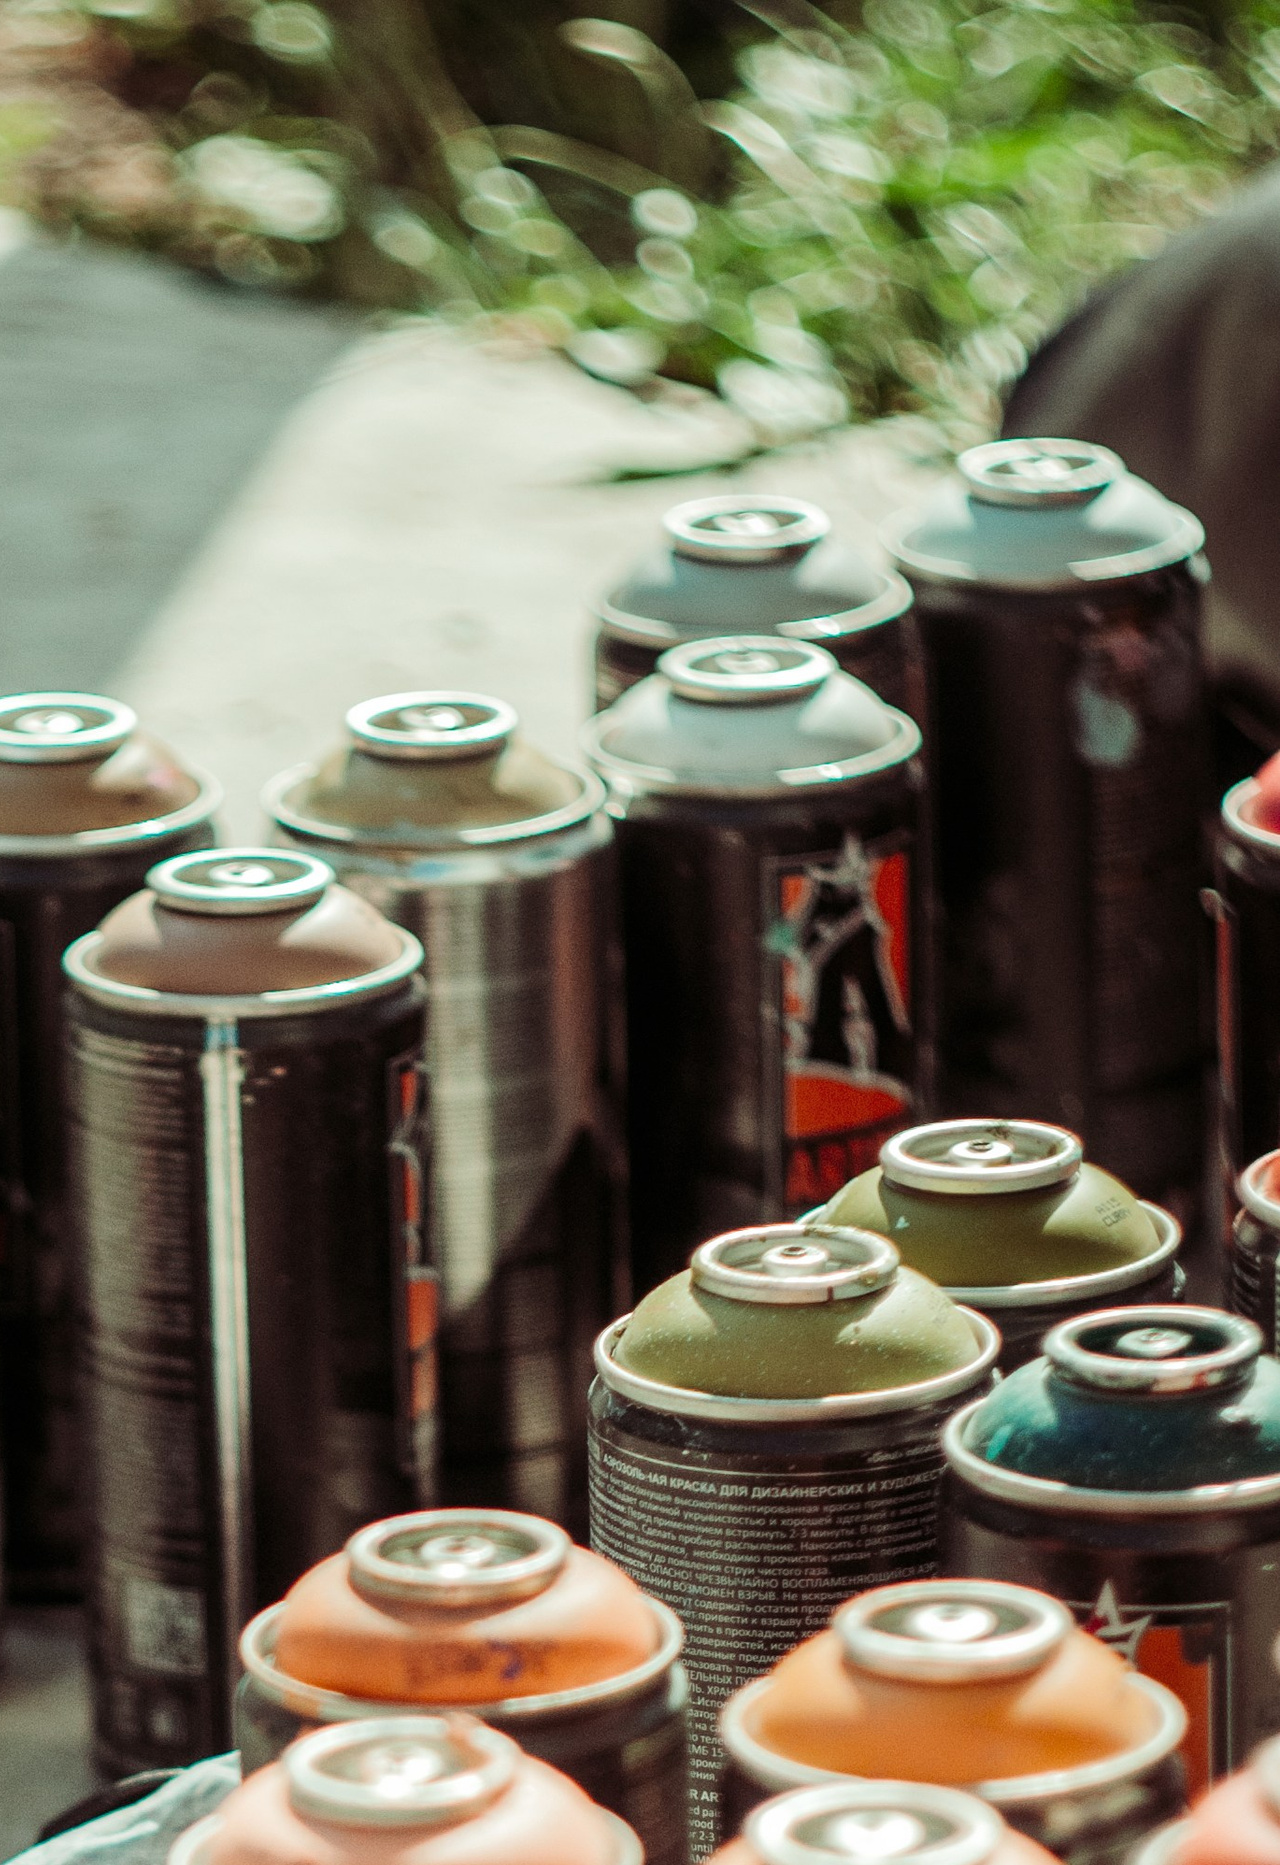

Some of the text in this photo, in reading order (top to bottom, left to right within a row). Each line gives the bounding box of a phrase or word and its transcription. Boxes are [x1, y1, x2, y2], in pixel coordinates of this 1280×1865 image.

[669, 1477, 717, 1494] КРАСКА
[720, 1485, 748, 1497] ДЛЯ
[751, 1483, 865, 1500] ДИЗАЙНЕРСКИХ
[867, 1481, 876, 1493] И
[674, 1496, 819, 1515] высокопигментированная
[823, 1502, 861, 1514] краска
[683, 1511, 766, 1526] укрывистостью
[769, 1518, 777, 1526] и
[780, 1514, 833, 1528] хорошей
[678, 1533, 722, 1548] пробное
[725, 1528, 787, 1541] встряхнуть
[692, 1549, 761, 1563] необходимо
[763, 1554, 828, 1566] прочистить
[695, 1571, 779, 1589] ЧРЕЗВЫЧАЙНО
[782, 1566, 916, 1589] ВОСПЛАМЕНЯЮЩИЙСЯ
[724, 1564, 755, 1577] струи
[758, 1567, 802, 1577] чистого
[673, 1581, 735, 1598] ВОЗМОЖЕН
[783, 1592, 798, 1600] Не
[694, 1598, 752, 1612] содержать
[754, 1604, 799, 1613] остатки
[698, 1611, 748, 1624] привести
[761, 1617, 801, 1627] взрыву
[725, 1627, 799, 1639] прохладном,
[690, 1635, 768, 1650] поверхностей,
